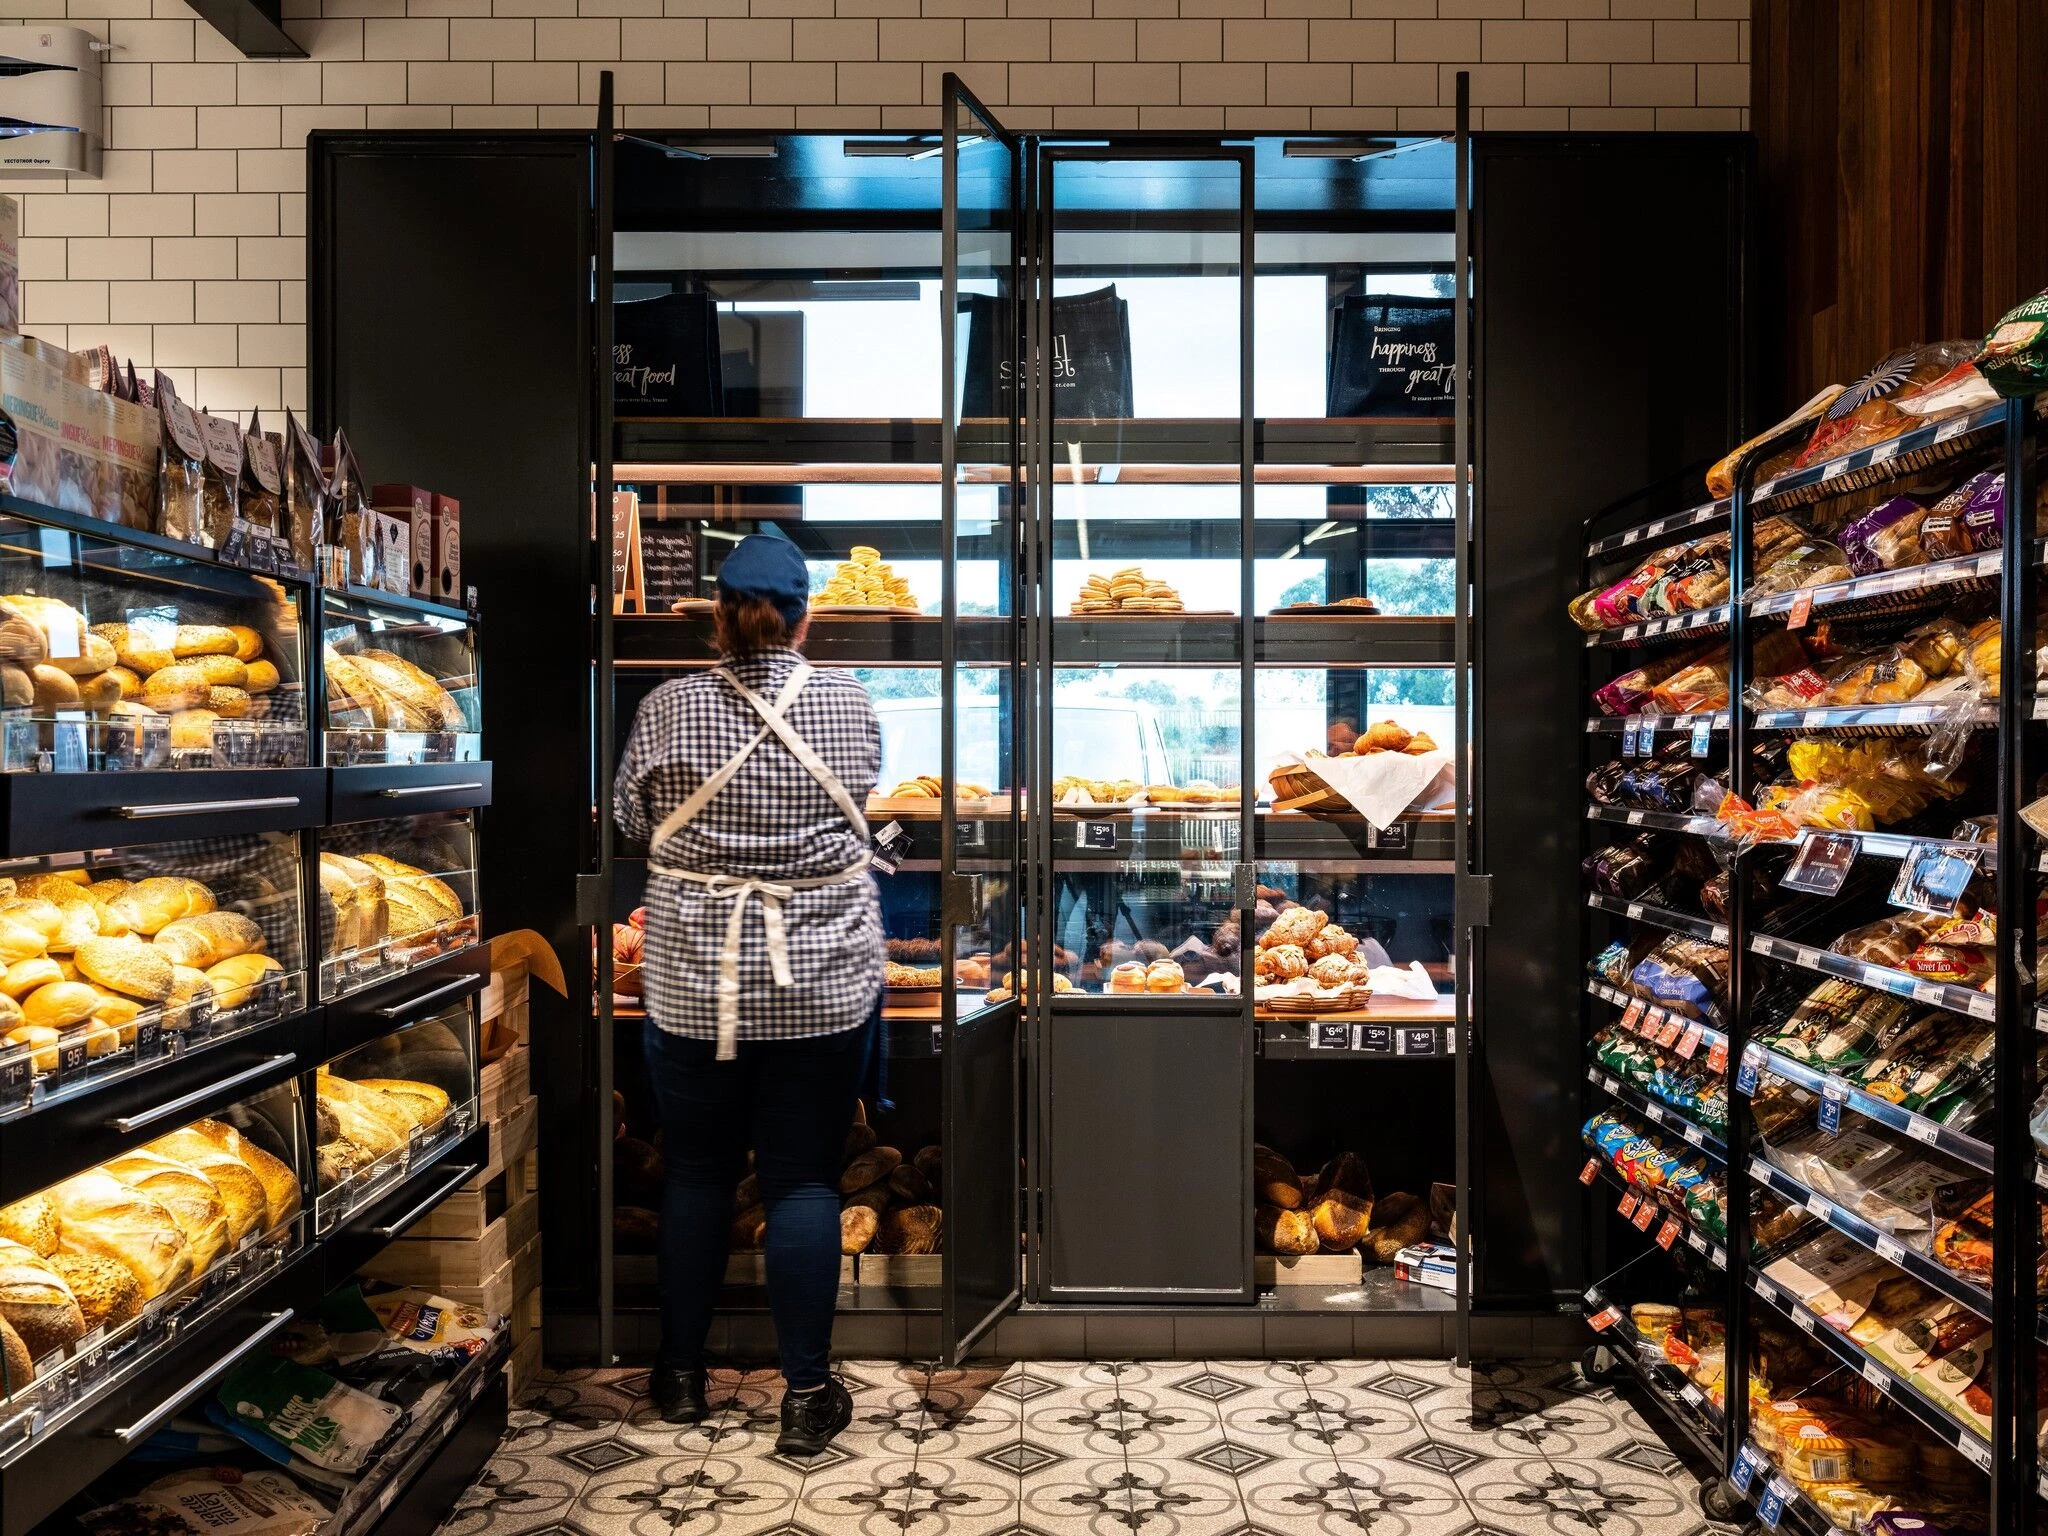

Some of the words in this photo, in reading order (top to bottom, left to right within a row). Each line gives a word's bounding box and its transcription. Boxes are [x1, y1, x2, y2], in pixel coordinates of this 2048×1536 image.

[1370, 336, 1438, 365] happiness
[640, 363, 676, 396] food
[1404, 363, 1450, 394] great
[102, 434, 138, 460] MERINGUE
[1093, 825, 1110, 835] $595
[1916, 961, 1936, 972] Street
[1325, 1026, 1343, 1036] $640
[1368, 1029, 1386, 1039] $550
[1411, 1032, 1430, 1042] $480
[199, 1491, 240, 1524] valley
